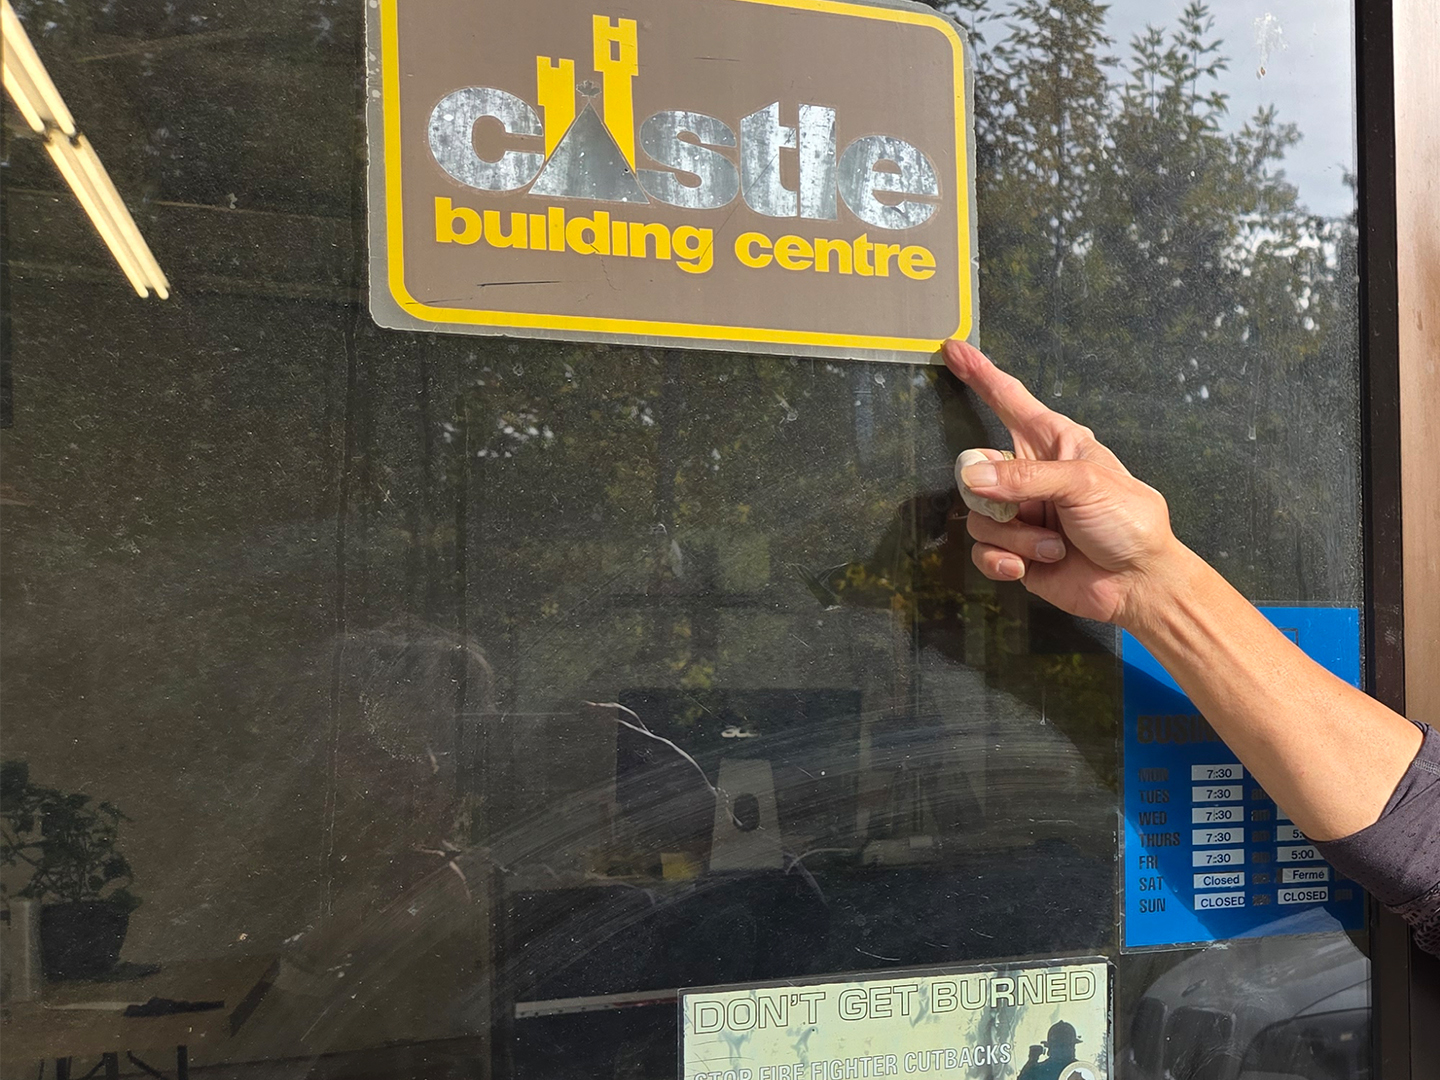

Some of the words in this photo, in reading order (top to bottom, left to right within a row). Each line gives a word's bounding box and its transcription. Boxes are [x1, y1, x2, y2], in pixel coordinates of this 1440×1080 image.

[434, 196, 714, 273] building
[735, 231, 936, 280] centre
[1207, 768, 1232, 778] 7:30
[1139, 789, 1169, 803] TUES
[1206, 789, 1231, 799] 7:30
[1138, 811, 1167, 825] WED
[1206, 810, 1232, 821] 7:30
[1139, 832, 1180, 848] THURS
[1206, 832, 1231, 843] 7:30
[1139, 855, 1158, 870] FRI
[1206, 853, 1231, 864] 7:30
[1291, 849, 1314, 860] 5:00
[1139, 875, 1163, 891] SAT
[1203, 875, 1240, 886] Closed
[1139, 898, 1166, 913] SUN
[1201, 896, 1245, 908] CLOSED
[1283, 891, 1327, 902] CLOSED
[694, 991, 826, 1034] DON'T
[838, 984, 918, 1021] GET
[931, 969, 1097, 1014] BURNED
[758, 1063, 805, 1080] FIRE
[810, 1053, 898, 1080] FIGHTER
[903, 1043, 1012, 1073] CUTBACKS
